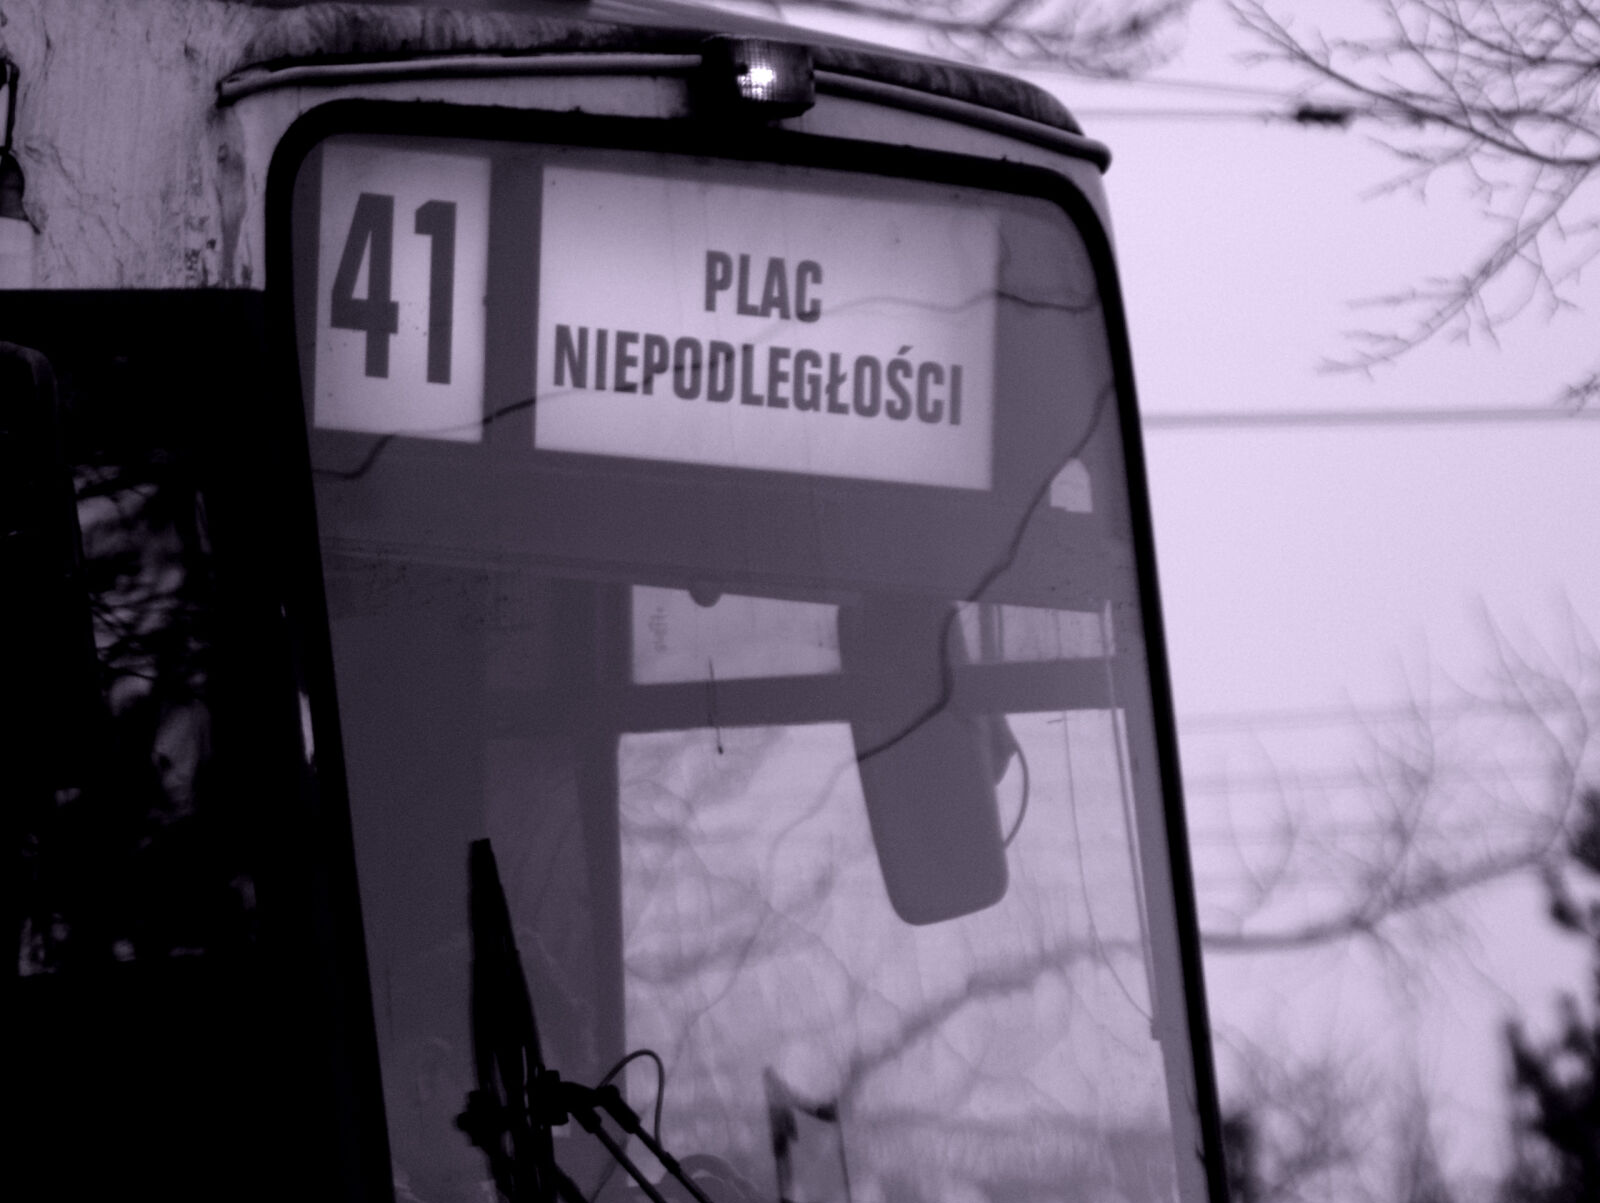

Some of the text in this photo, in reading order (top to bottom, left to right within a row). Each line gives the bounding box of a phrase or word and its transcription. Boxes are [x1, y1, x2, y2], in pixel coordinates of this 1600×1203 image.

[330, 192, 457, 385] 41
[704, 249, 824, 324] PLAC
[553, 323, 965, 427] NIEPODLEGŁOŚCI
